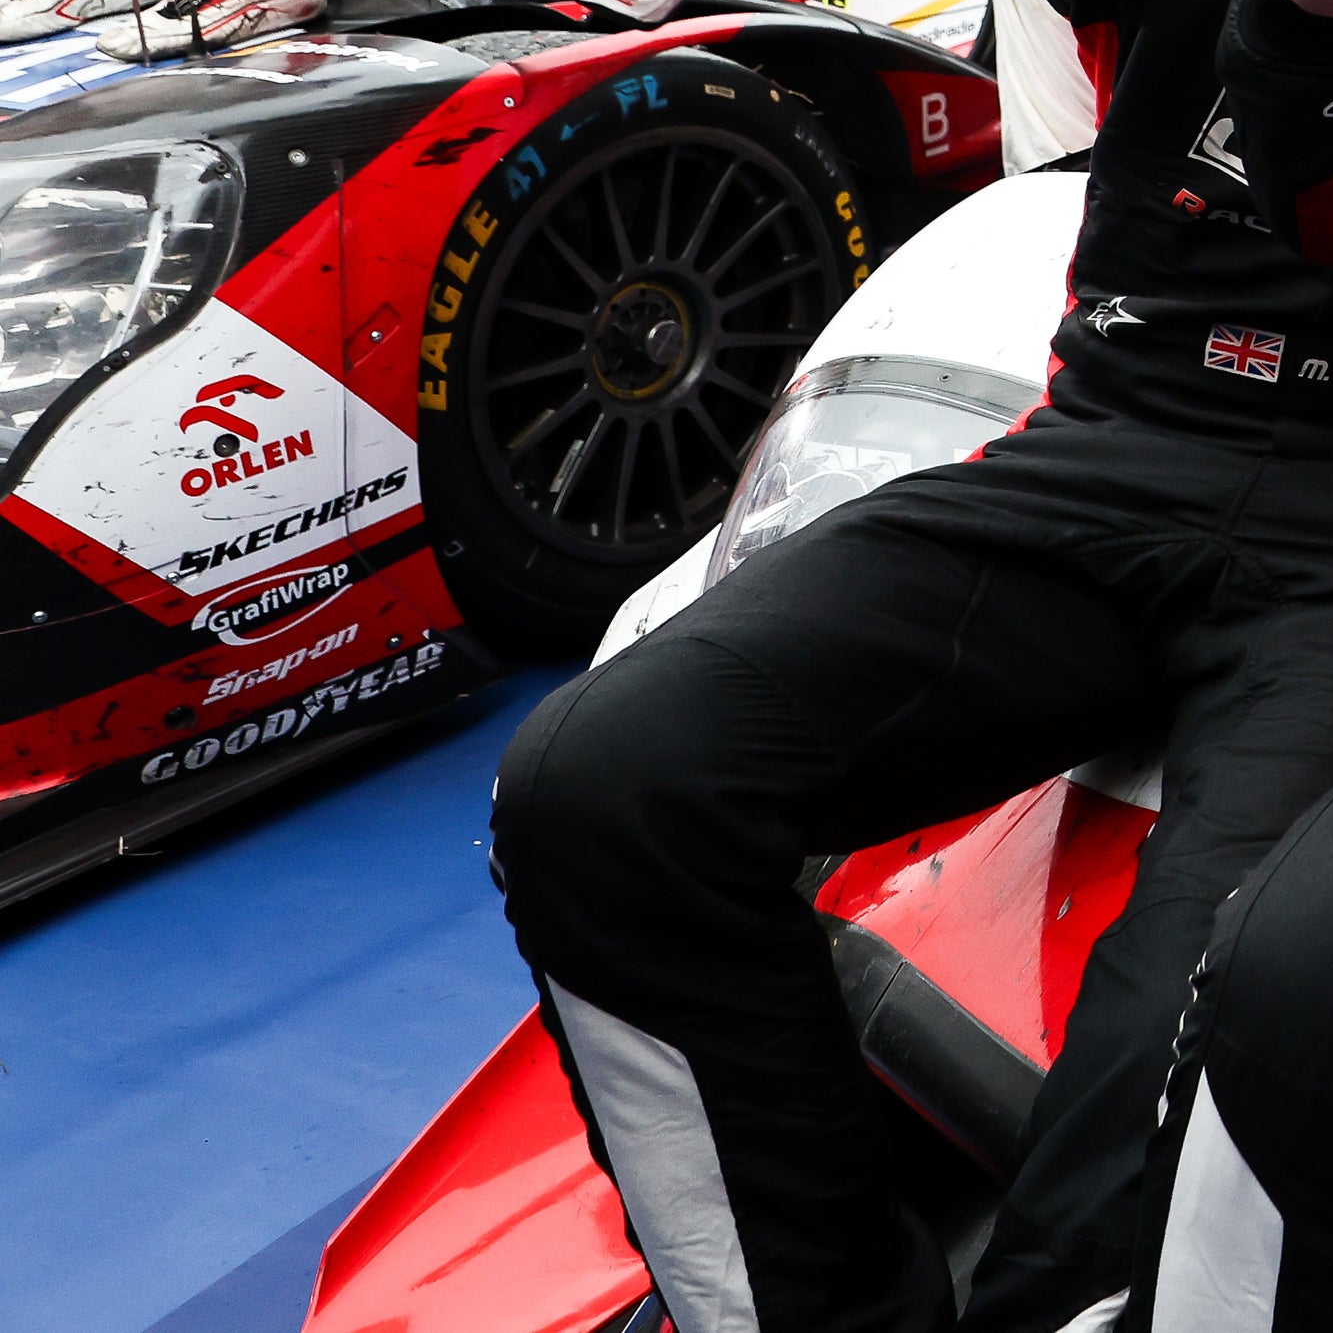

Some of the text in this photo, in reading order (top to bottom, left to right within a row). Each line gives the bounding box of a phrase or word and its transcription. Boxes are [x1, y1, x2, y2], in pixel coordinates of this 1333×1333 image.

[613, 74, 667, 119] FL
[921, 92, 949, 144] B
[416, 200, 499, 411] EAGLE
[180, 430, 314, 497] ORLEN
[177, 467, 409, 579] SKECHERS
[207, 563, 349, 634] GrafiWrap
[202, 623, 359, 706] Snap-on
[140, 631, 447, 785] GOODYEAR
